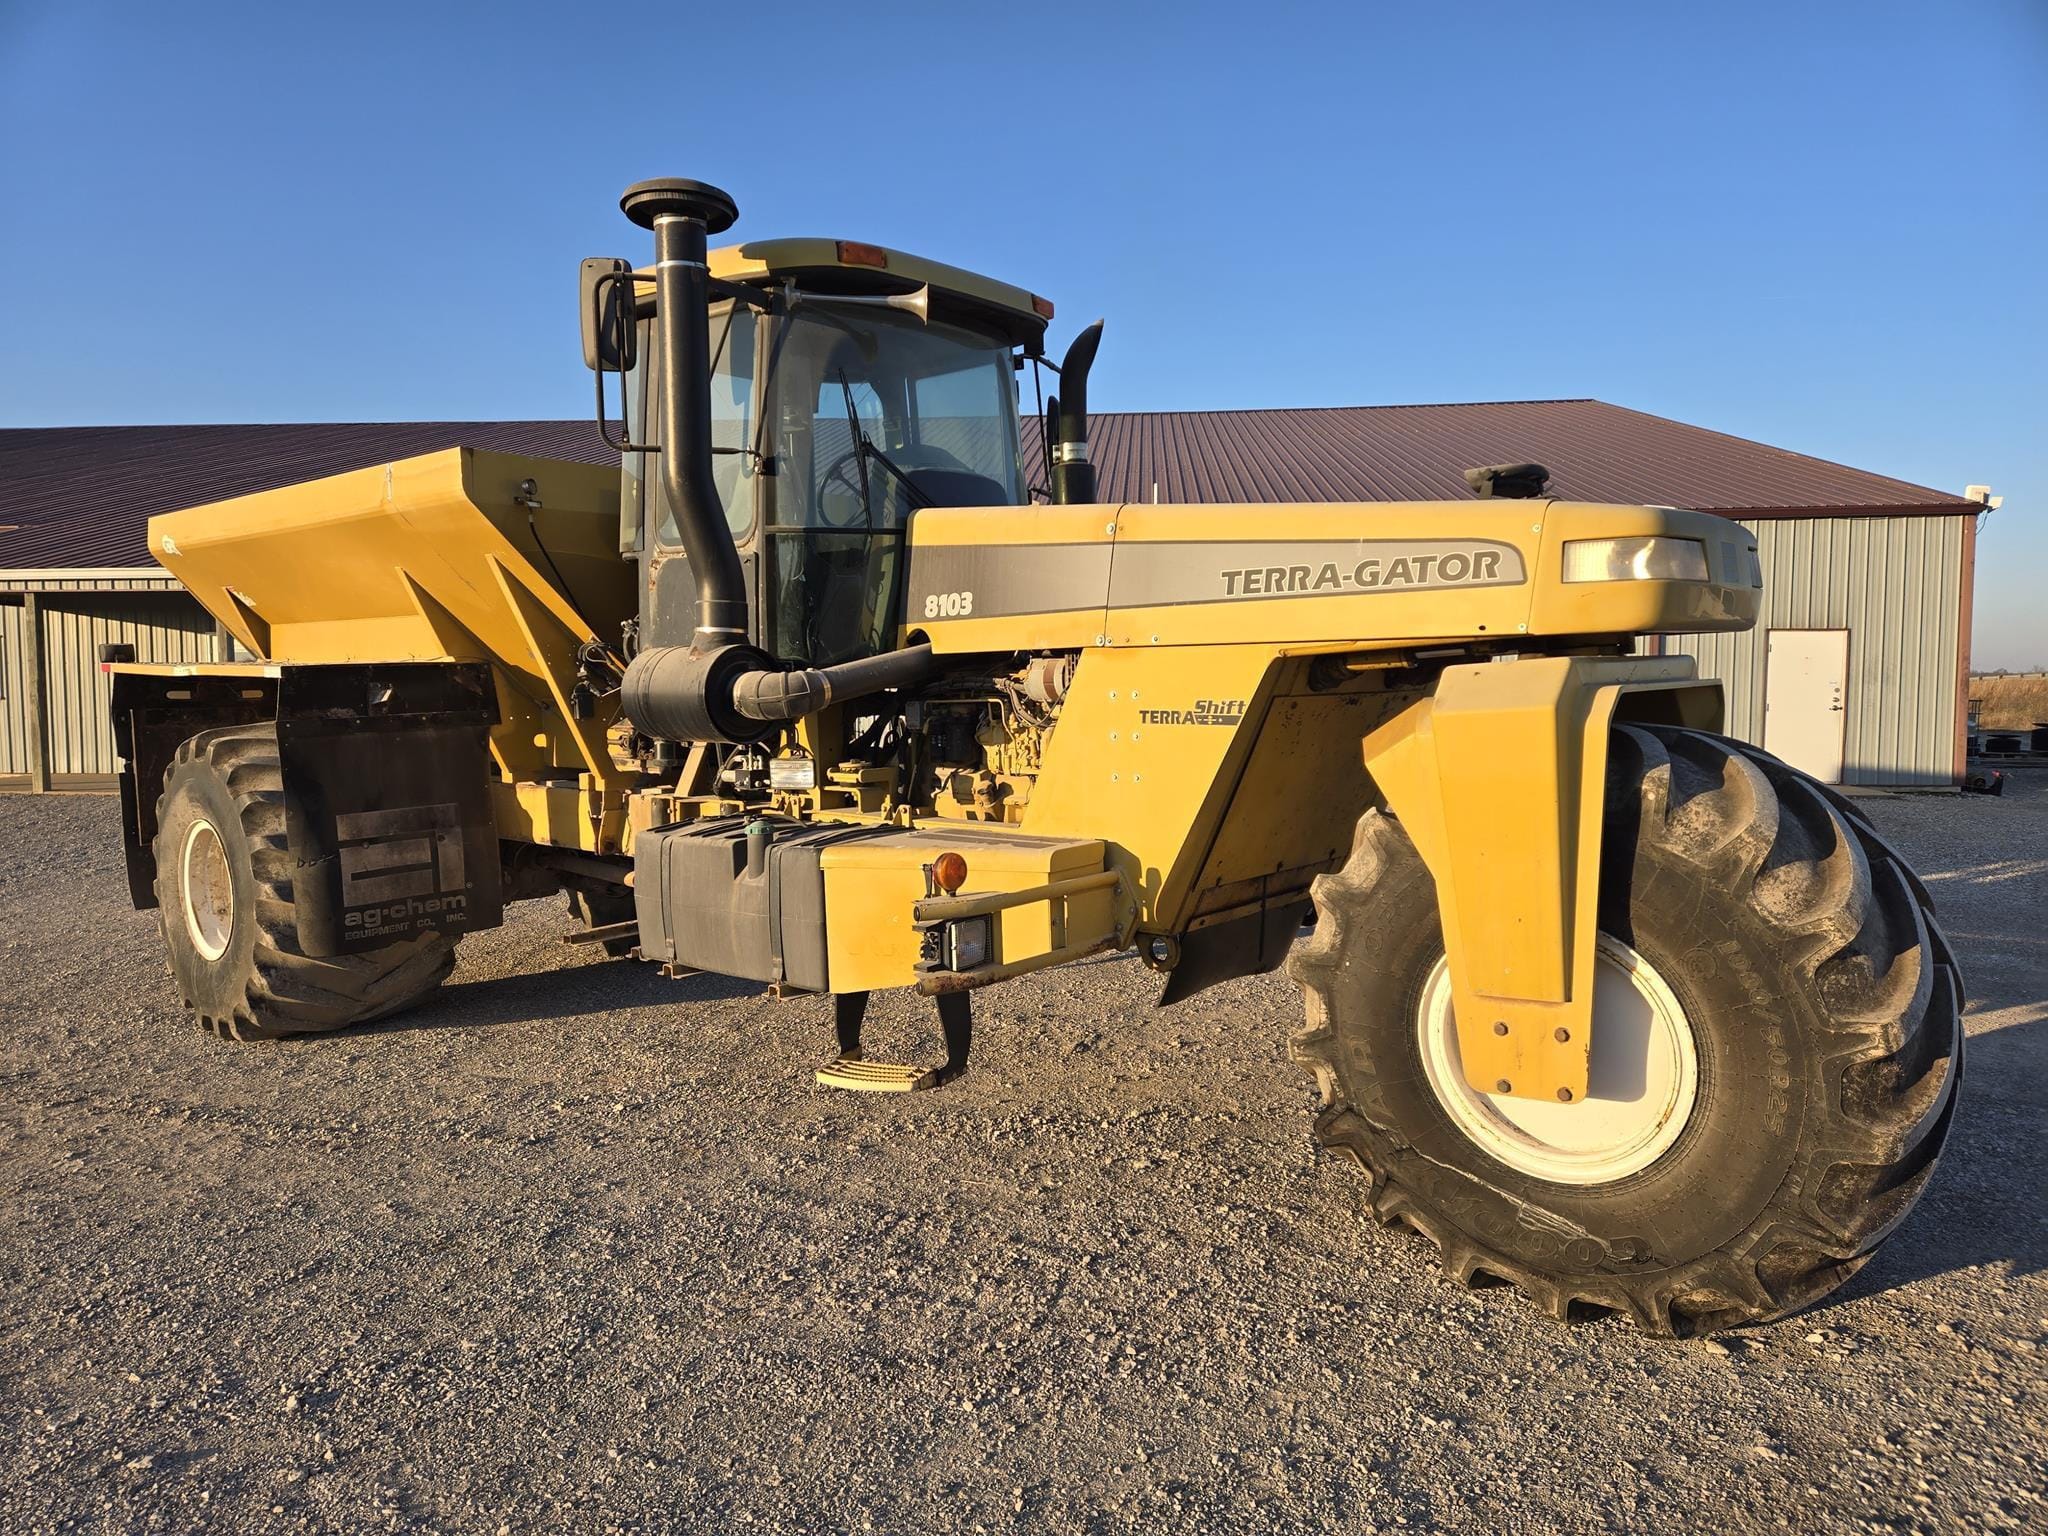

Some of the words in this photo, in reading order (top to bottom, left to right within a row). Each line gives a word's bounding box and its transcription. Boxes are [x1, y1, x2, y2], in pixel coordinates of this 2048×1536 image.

[1221, 550, 1502, 596] TERRA-GATOR
[924, 591, 973, 618] 8103
[1139, 710, 1195, 725] TERRA
[1194, 700, 1246, 714] Shift
[344, 921, 410, 941] EQUIPMENT
